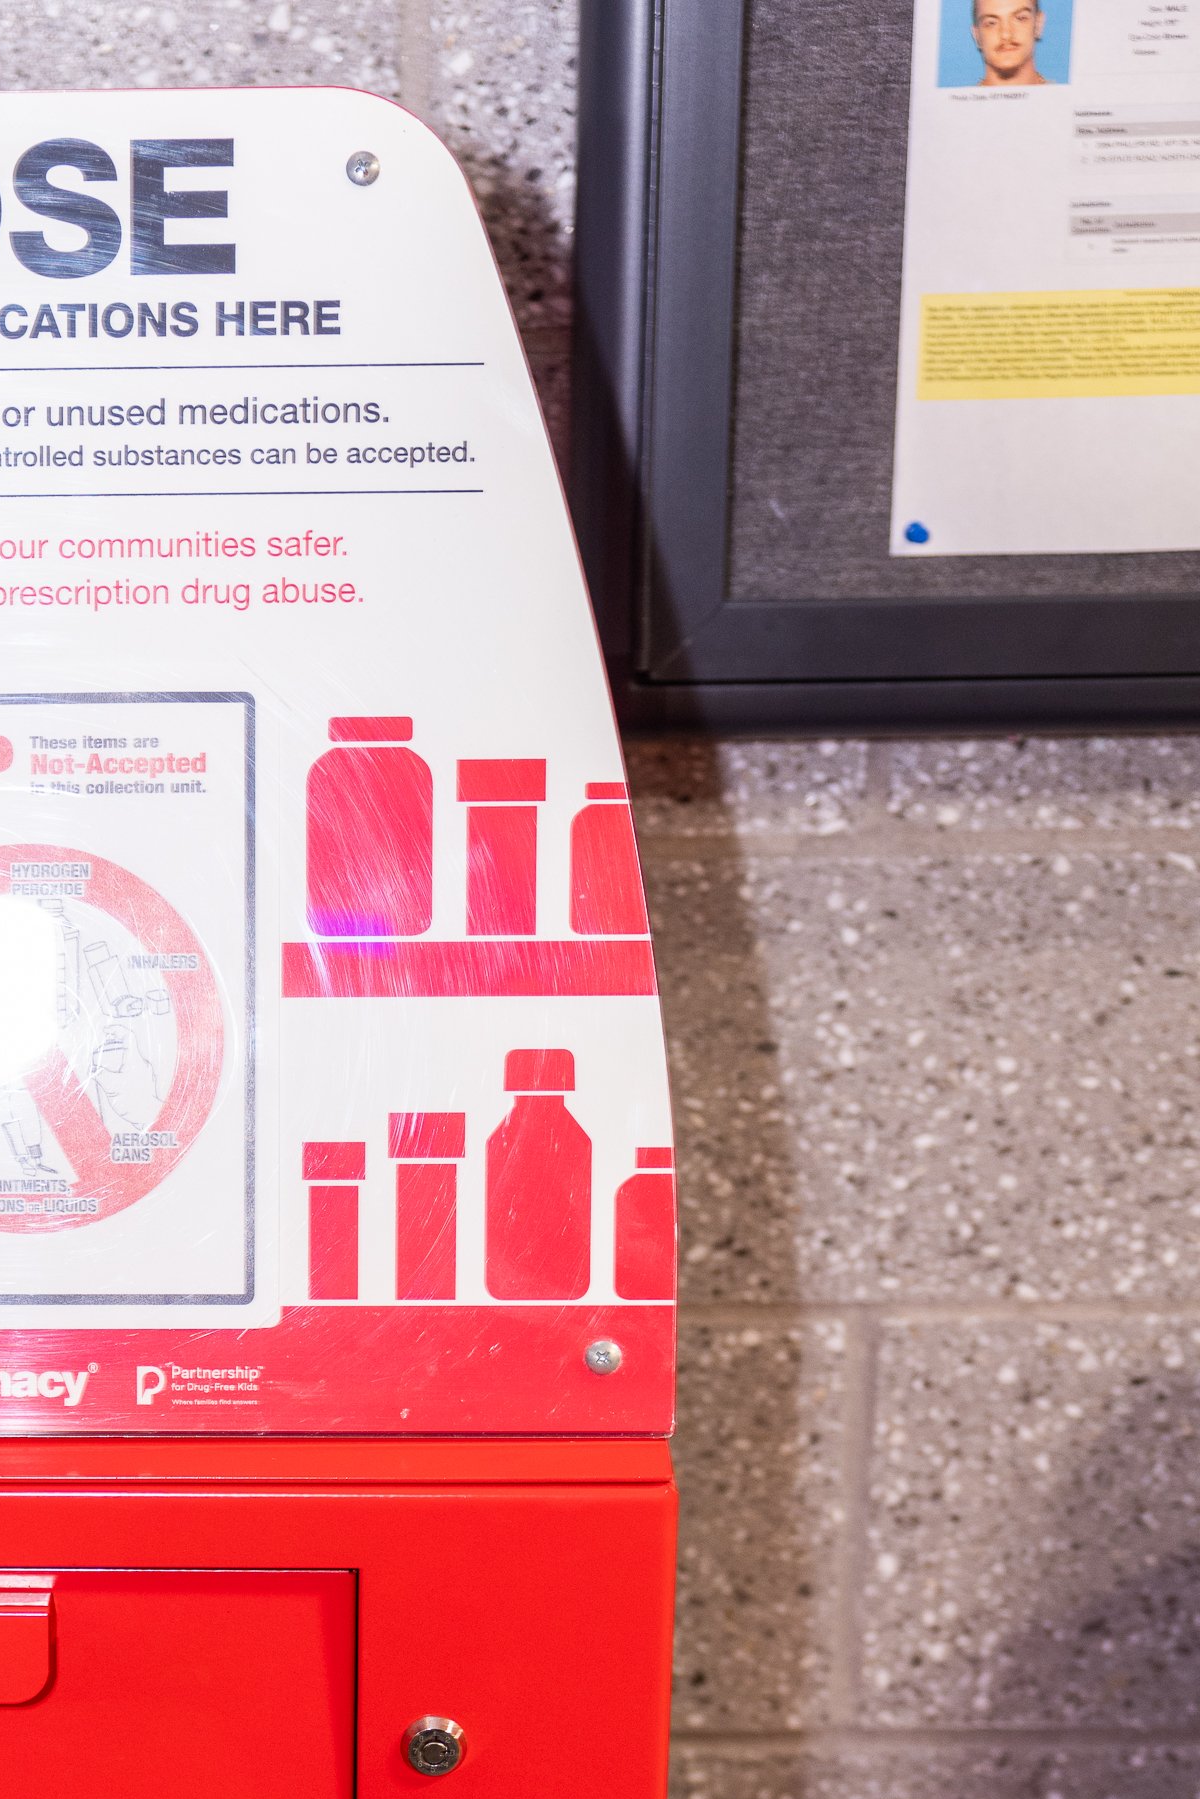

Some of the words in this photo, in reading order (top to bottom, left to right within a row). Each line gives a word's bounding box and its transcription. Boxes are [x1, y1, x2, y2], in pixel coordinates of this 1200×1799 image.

[216, 300, 340, 336] HERE
[2, 407, 35, 427] or
[47, 398, 165, 426] unused
[179, 396, 388, 425] medications.
[93, 445, 241, 466] substances
[251, 448, 296, 464] can
[307, 443, 337, 464] be
[347, 441, 475, 468] accepted.
[0, 540, 48, 559] our
[59, 531, 256, 558] communities
[267, 530, 347, 557] safer.
[181, 578, 250, 611] drug
[262, 577, 363, 603] abuse.
[29, 736, 77, 749] These
[83, 736, 127, 749] items
[134, 738, 159, 748] are
[31, 752, 206, 778] Not-Accepted
[86, 780, 165, 794] collection
[170, 780, 206, 793] unit.
[11, 864, 90, 879] HYDROGEN
[11, 883, 83, 896] PEROXIDE
[111, 1147, 151, 1163] CANS
[171, 1383, 185, 1391] for
[187, 1383, 236, 1393] Drug-Free
[238, 1383, 258, 1391] Kids
